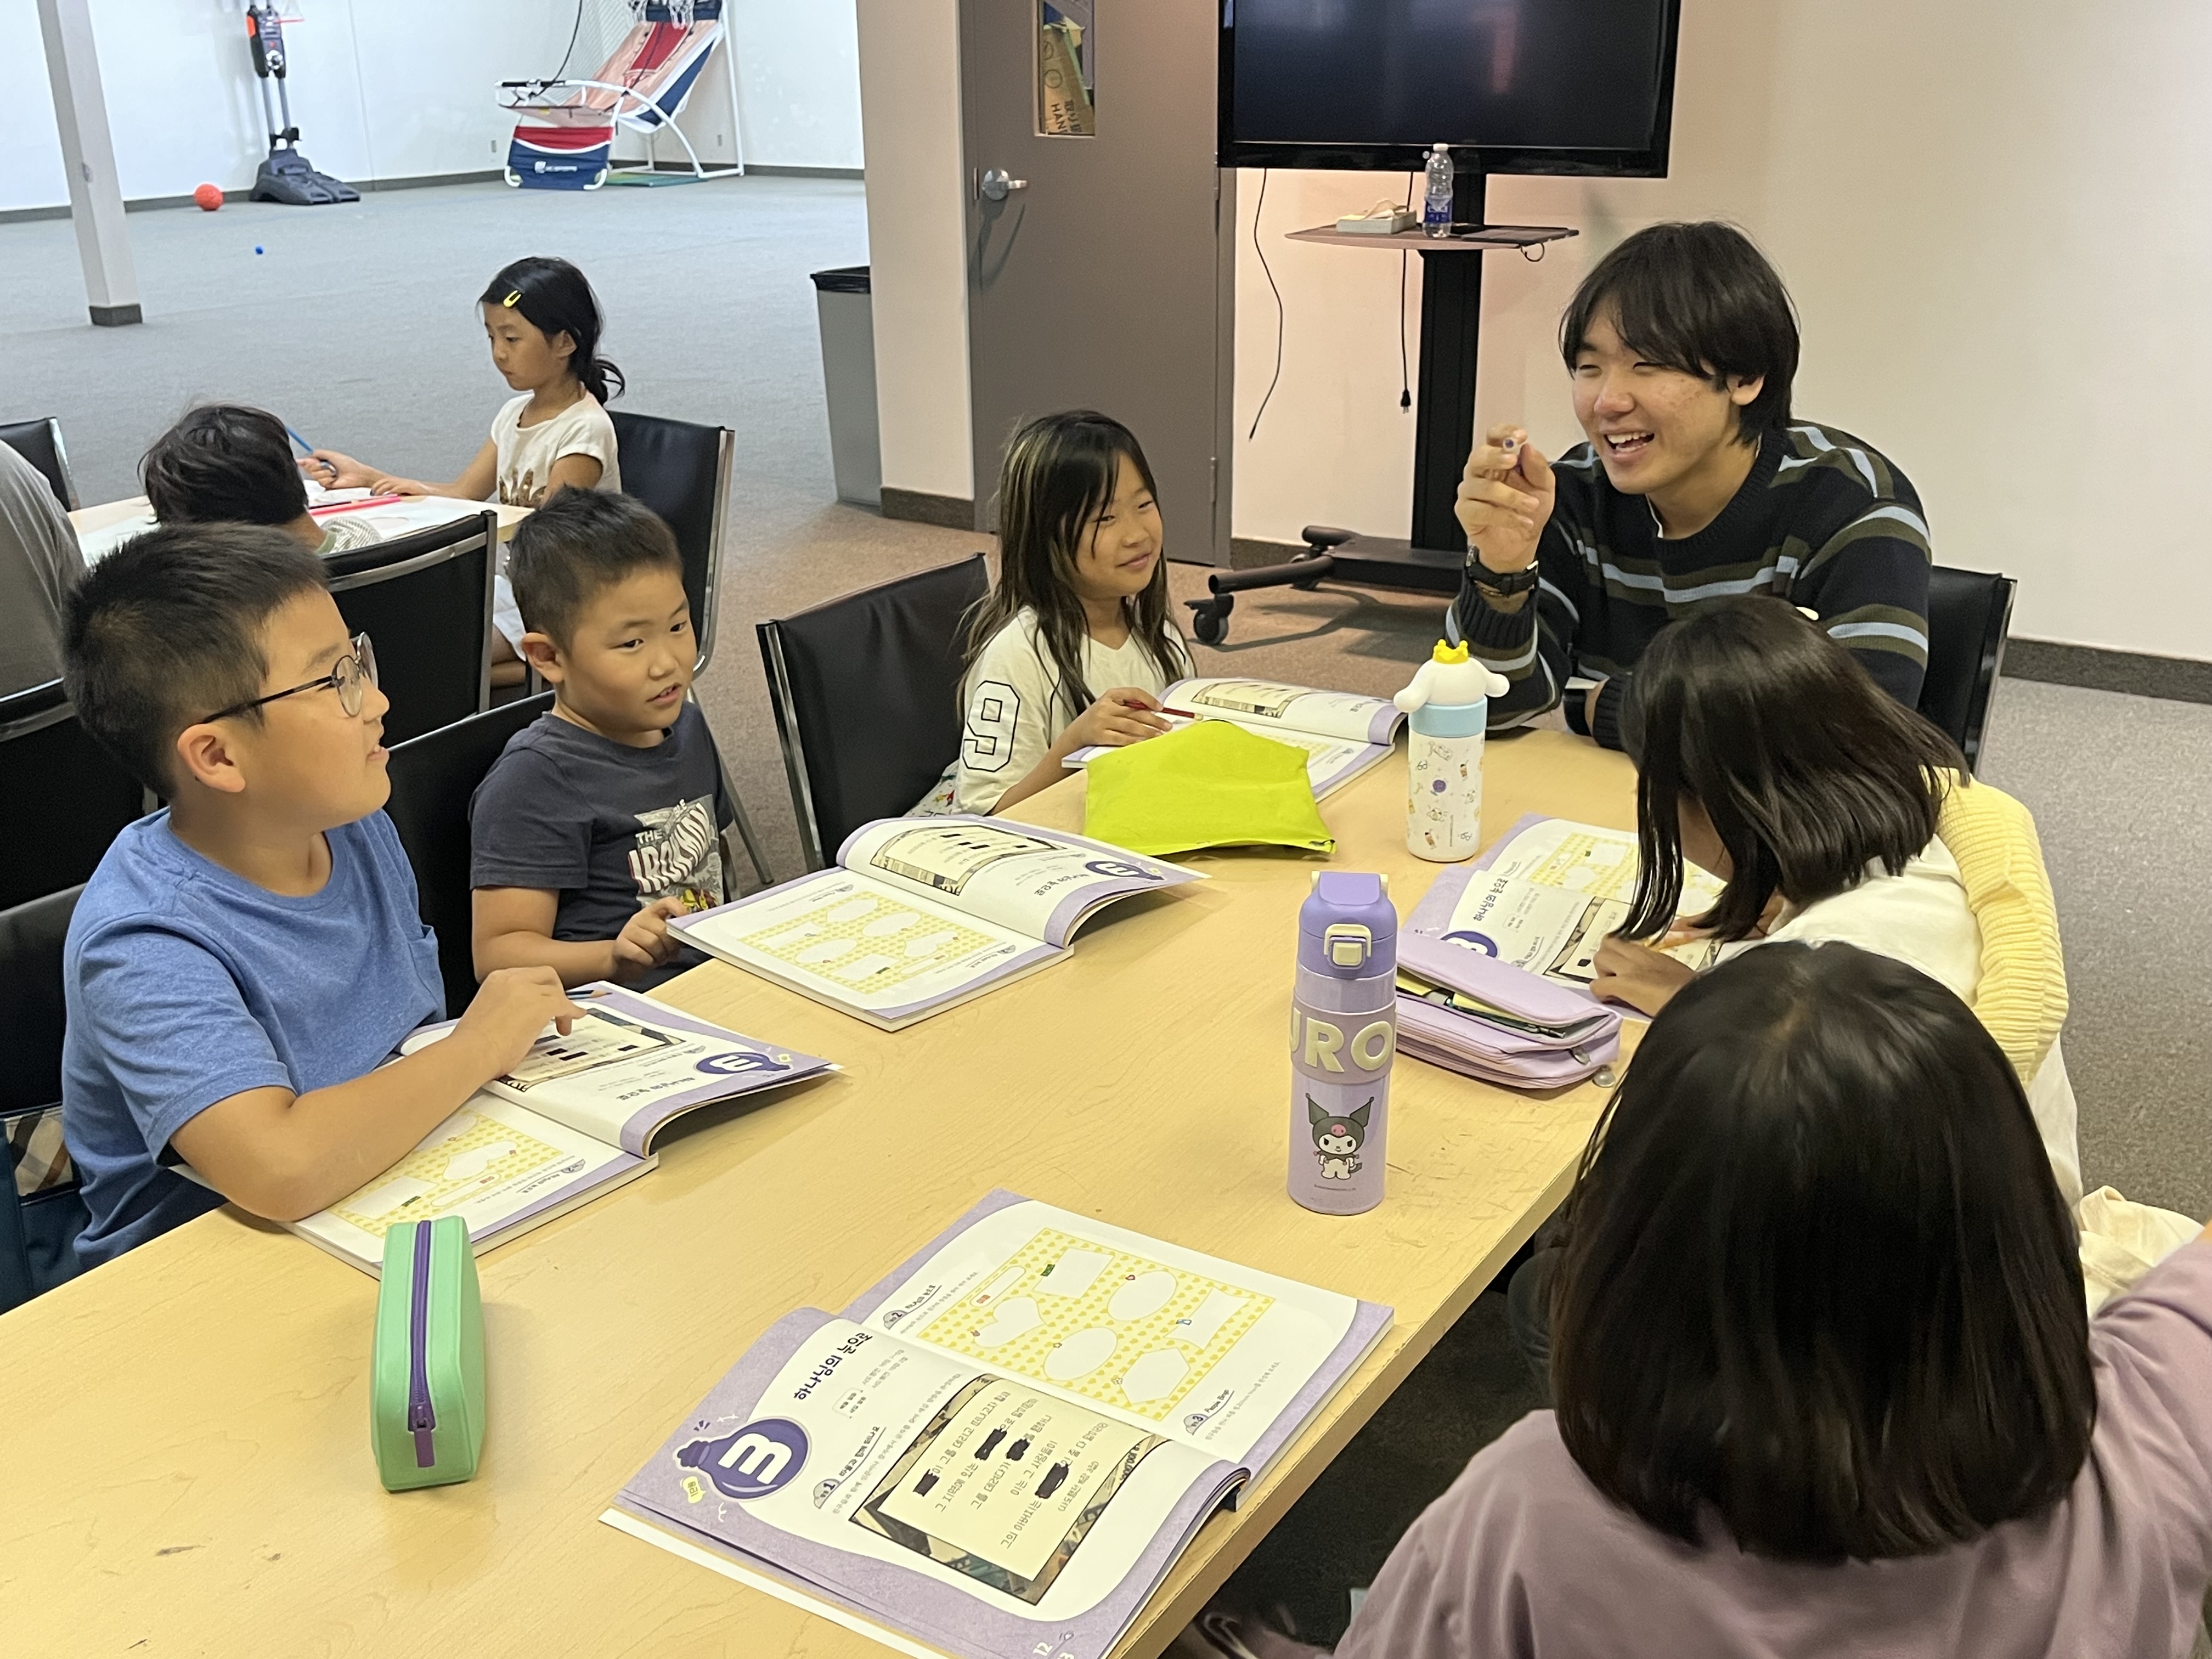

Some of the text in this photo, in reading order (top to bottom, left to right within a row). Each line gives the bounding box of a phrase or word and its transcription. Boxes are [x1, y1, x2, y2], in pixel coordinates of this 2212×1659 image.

[962, 680, 1020, 772] 9
[635, 829, 663, 844] THE
[1473, 878, 1509, 921] 하나님의 눈으로
[793, 1355, 843, 1401] 하나님의
[838, 1332, 873, 1355] 눈으로
[718, 1433, 792, 1485] 3
[940, 1449, 957, 1464] 그를
[952, 1427, 974, 1448] 데리고
[1010, 1441, 1057, 1495] 이는 그 사람들이
[961, 1463, 978, 1479] 있는
[970, 1493, 988, 1509] 그를
[984, 1462, 1011, 1492] 데려다가
[1001, 1531, 1018, 1549] 그의
[1014, 1500, 1042, 1531] 아버지는
[1032, 1641, 1053, 1656] 12
